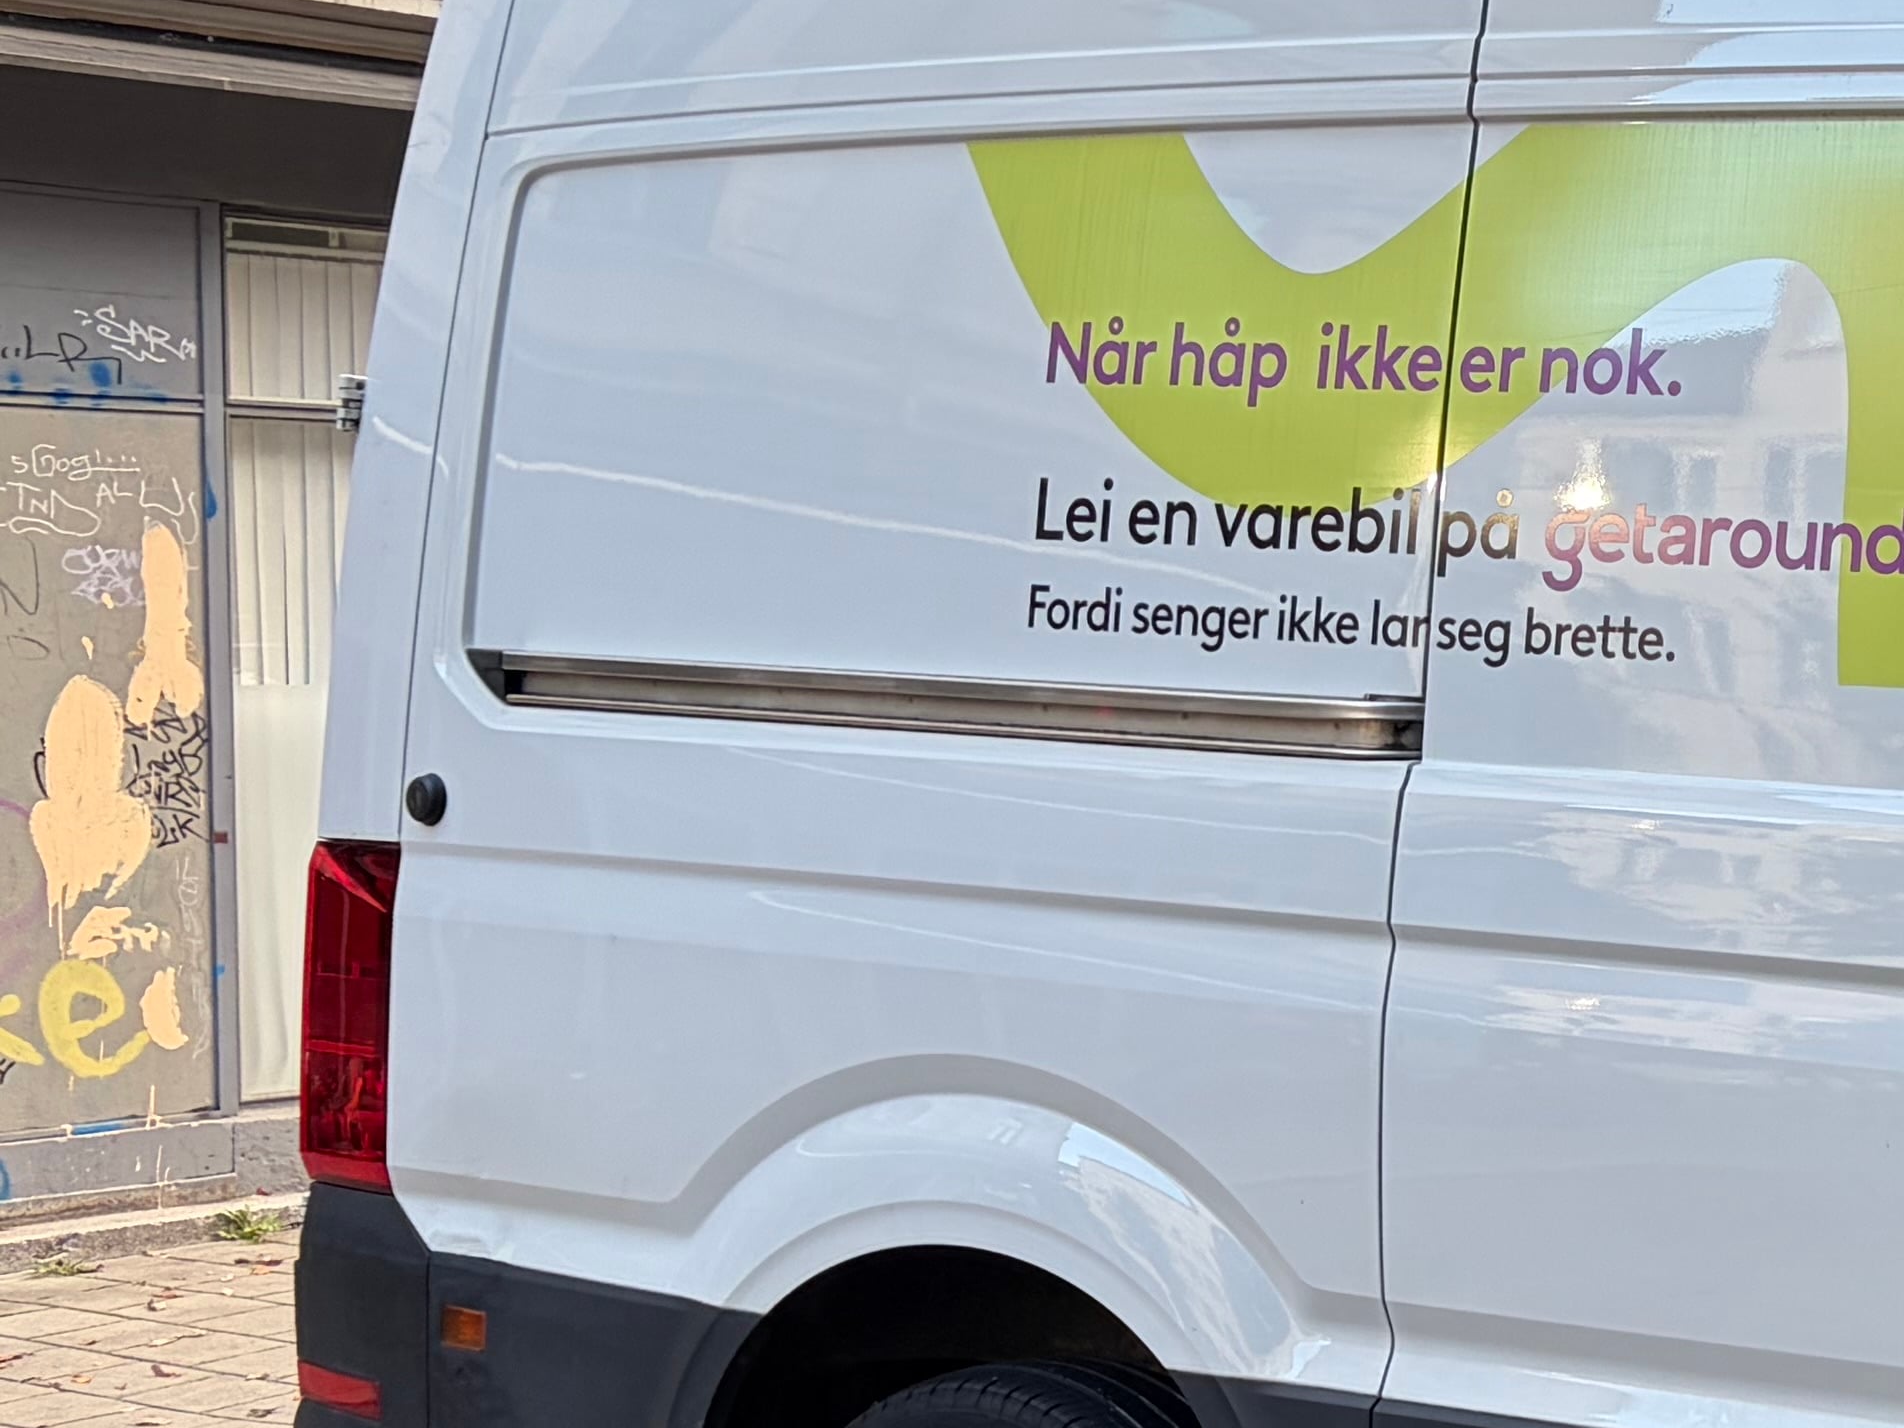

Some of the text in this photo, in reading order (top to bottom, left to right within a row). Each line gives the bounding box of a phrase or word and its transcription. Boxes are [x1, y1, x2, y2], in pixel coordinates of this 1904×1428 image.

[1046, 316, 1682, 408] Når håp ikke er nok.
[1035, 476, 1115, 543] Lei
[1128, 498, 1198, 546] en
[1214, 486, 1421, 555] varebil
[1435, 487, 1521, 578] på
[1027, 583, 1676, 668] Fordi senger ikke lar seg brette.
